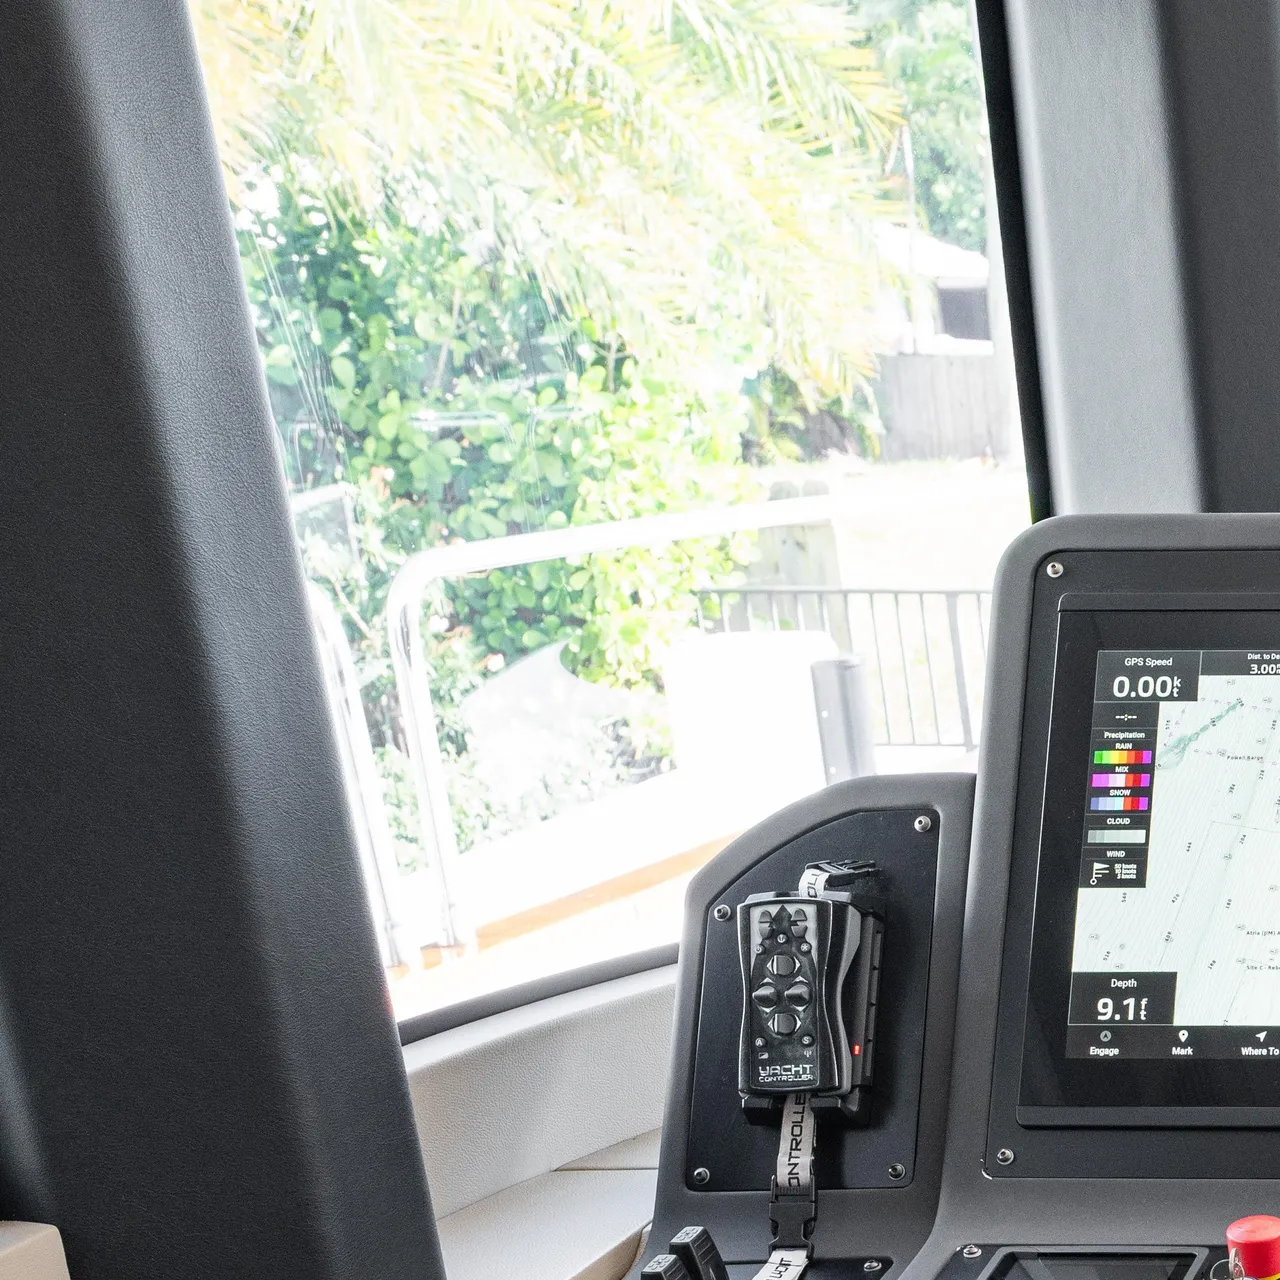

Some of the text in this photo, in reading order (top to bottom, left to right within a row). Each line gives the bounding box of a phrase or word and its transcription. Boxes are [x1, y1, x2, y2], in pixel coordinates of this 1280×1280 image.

[1124, 657, 1173, 668] GPS Speed
[1104, 731, 1145, 740] Precipitation
[1115, 742, 1133, 750] RAIN
[1106, 817, 1131, 825] CLOUD
[1106, 850, 1125, 858] WIND
[1110, 978, 1137, 988] Depth
[1089, 1047, 1119, 1057] Engage
[1172, 1046, 1193, 1056] Mark
[1241, 1046, 1279, 1056] Where To
[758, 1065, 814, 1075] YACHT
[758, 1074, 814, 1083] CONTROLLER
[788, 1093, 806, 1187] ONTROLLE
